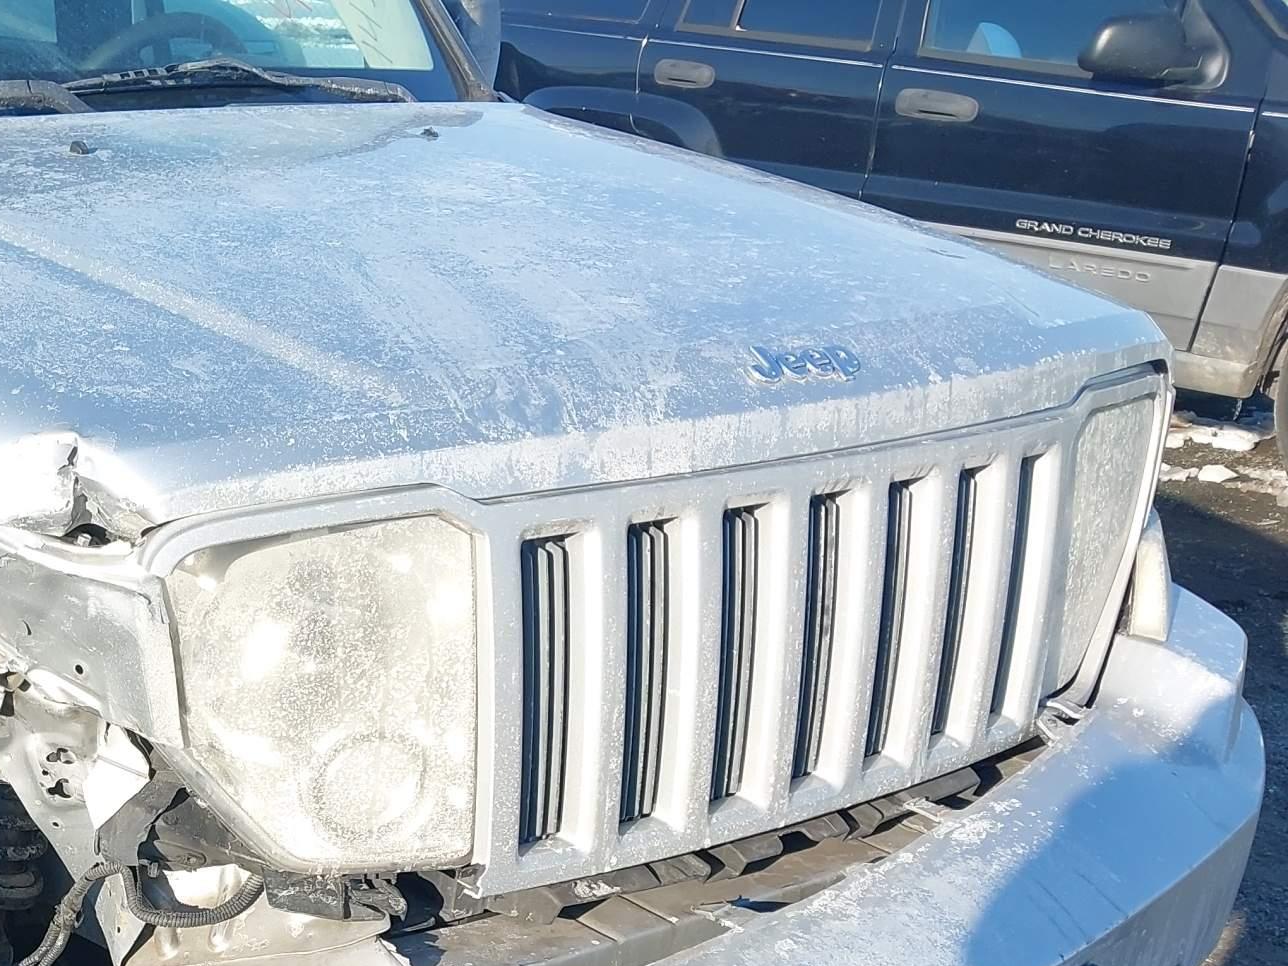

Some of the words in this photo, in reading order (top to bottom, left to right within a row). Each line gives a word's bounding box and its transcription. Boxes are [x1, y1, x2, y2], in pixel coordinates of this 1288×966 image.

[1015, 218, 1074, 236] GRAND
[1077, 227, 1172, 250] CHEROKEE
[1048, 253, 1152, 283] LAREDO
[745, 344, 861, 384] Jeep
